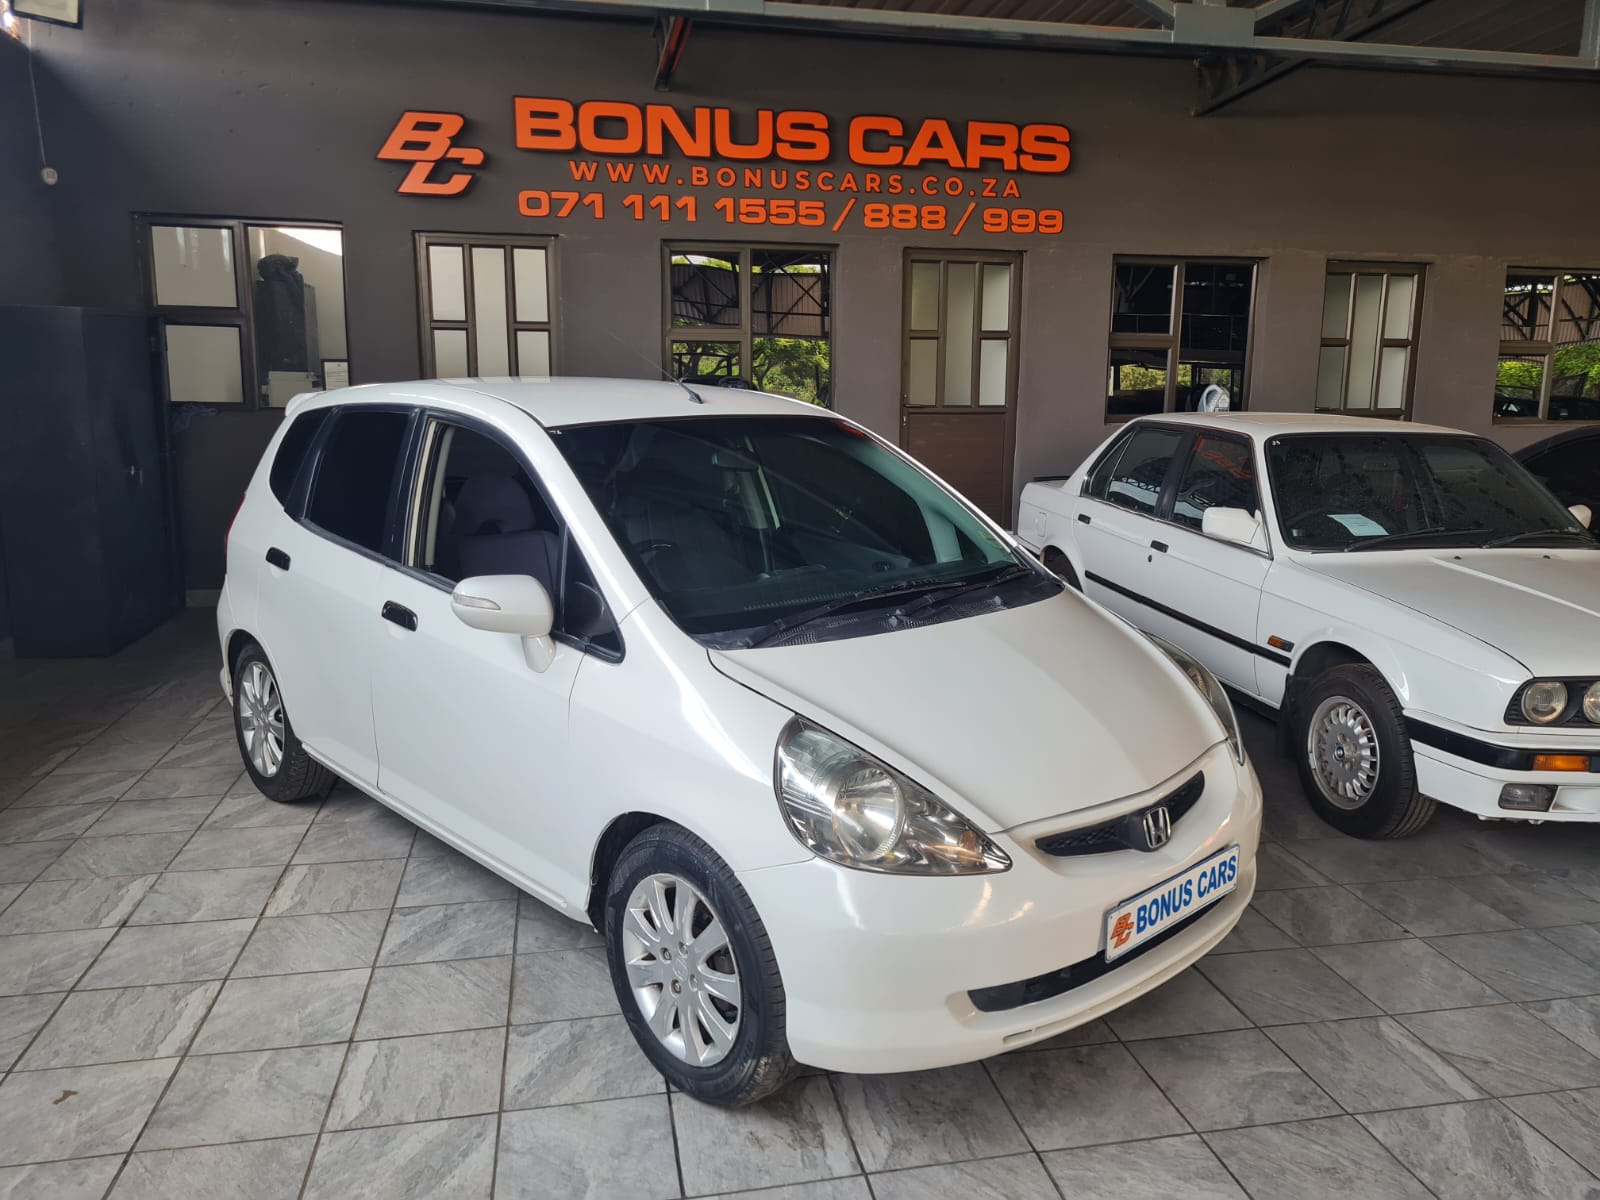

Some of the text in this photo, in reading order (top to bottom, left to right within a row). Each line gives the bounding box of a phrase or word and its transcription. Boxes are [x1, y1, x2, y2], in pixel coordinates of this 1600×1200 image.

[514, 95, 1071, 173] BONUS CARS
[518, 189, 604, 219] 071
[623, 193, 697, 222] 111
[569, 160, 1021, 198] WWW.BONUSCARS.CO.ZA
[1136, 878, 1193, 935] BONUS
[1197, 855, 1237, 899] CARS
